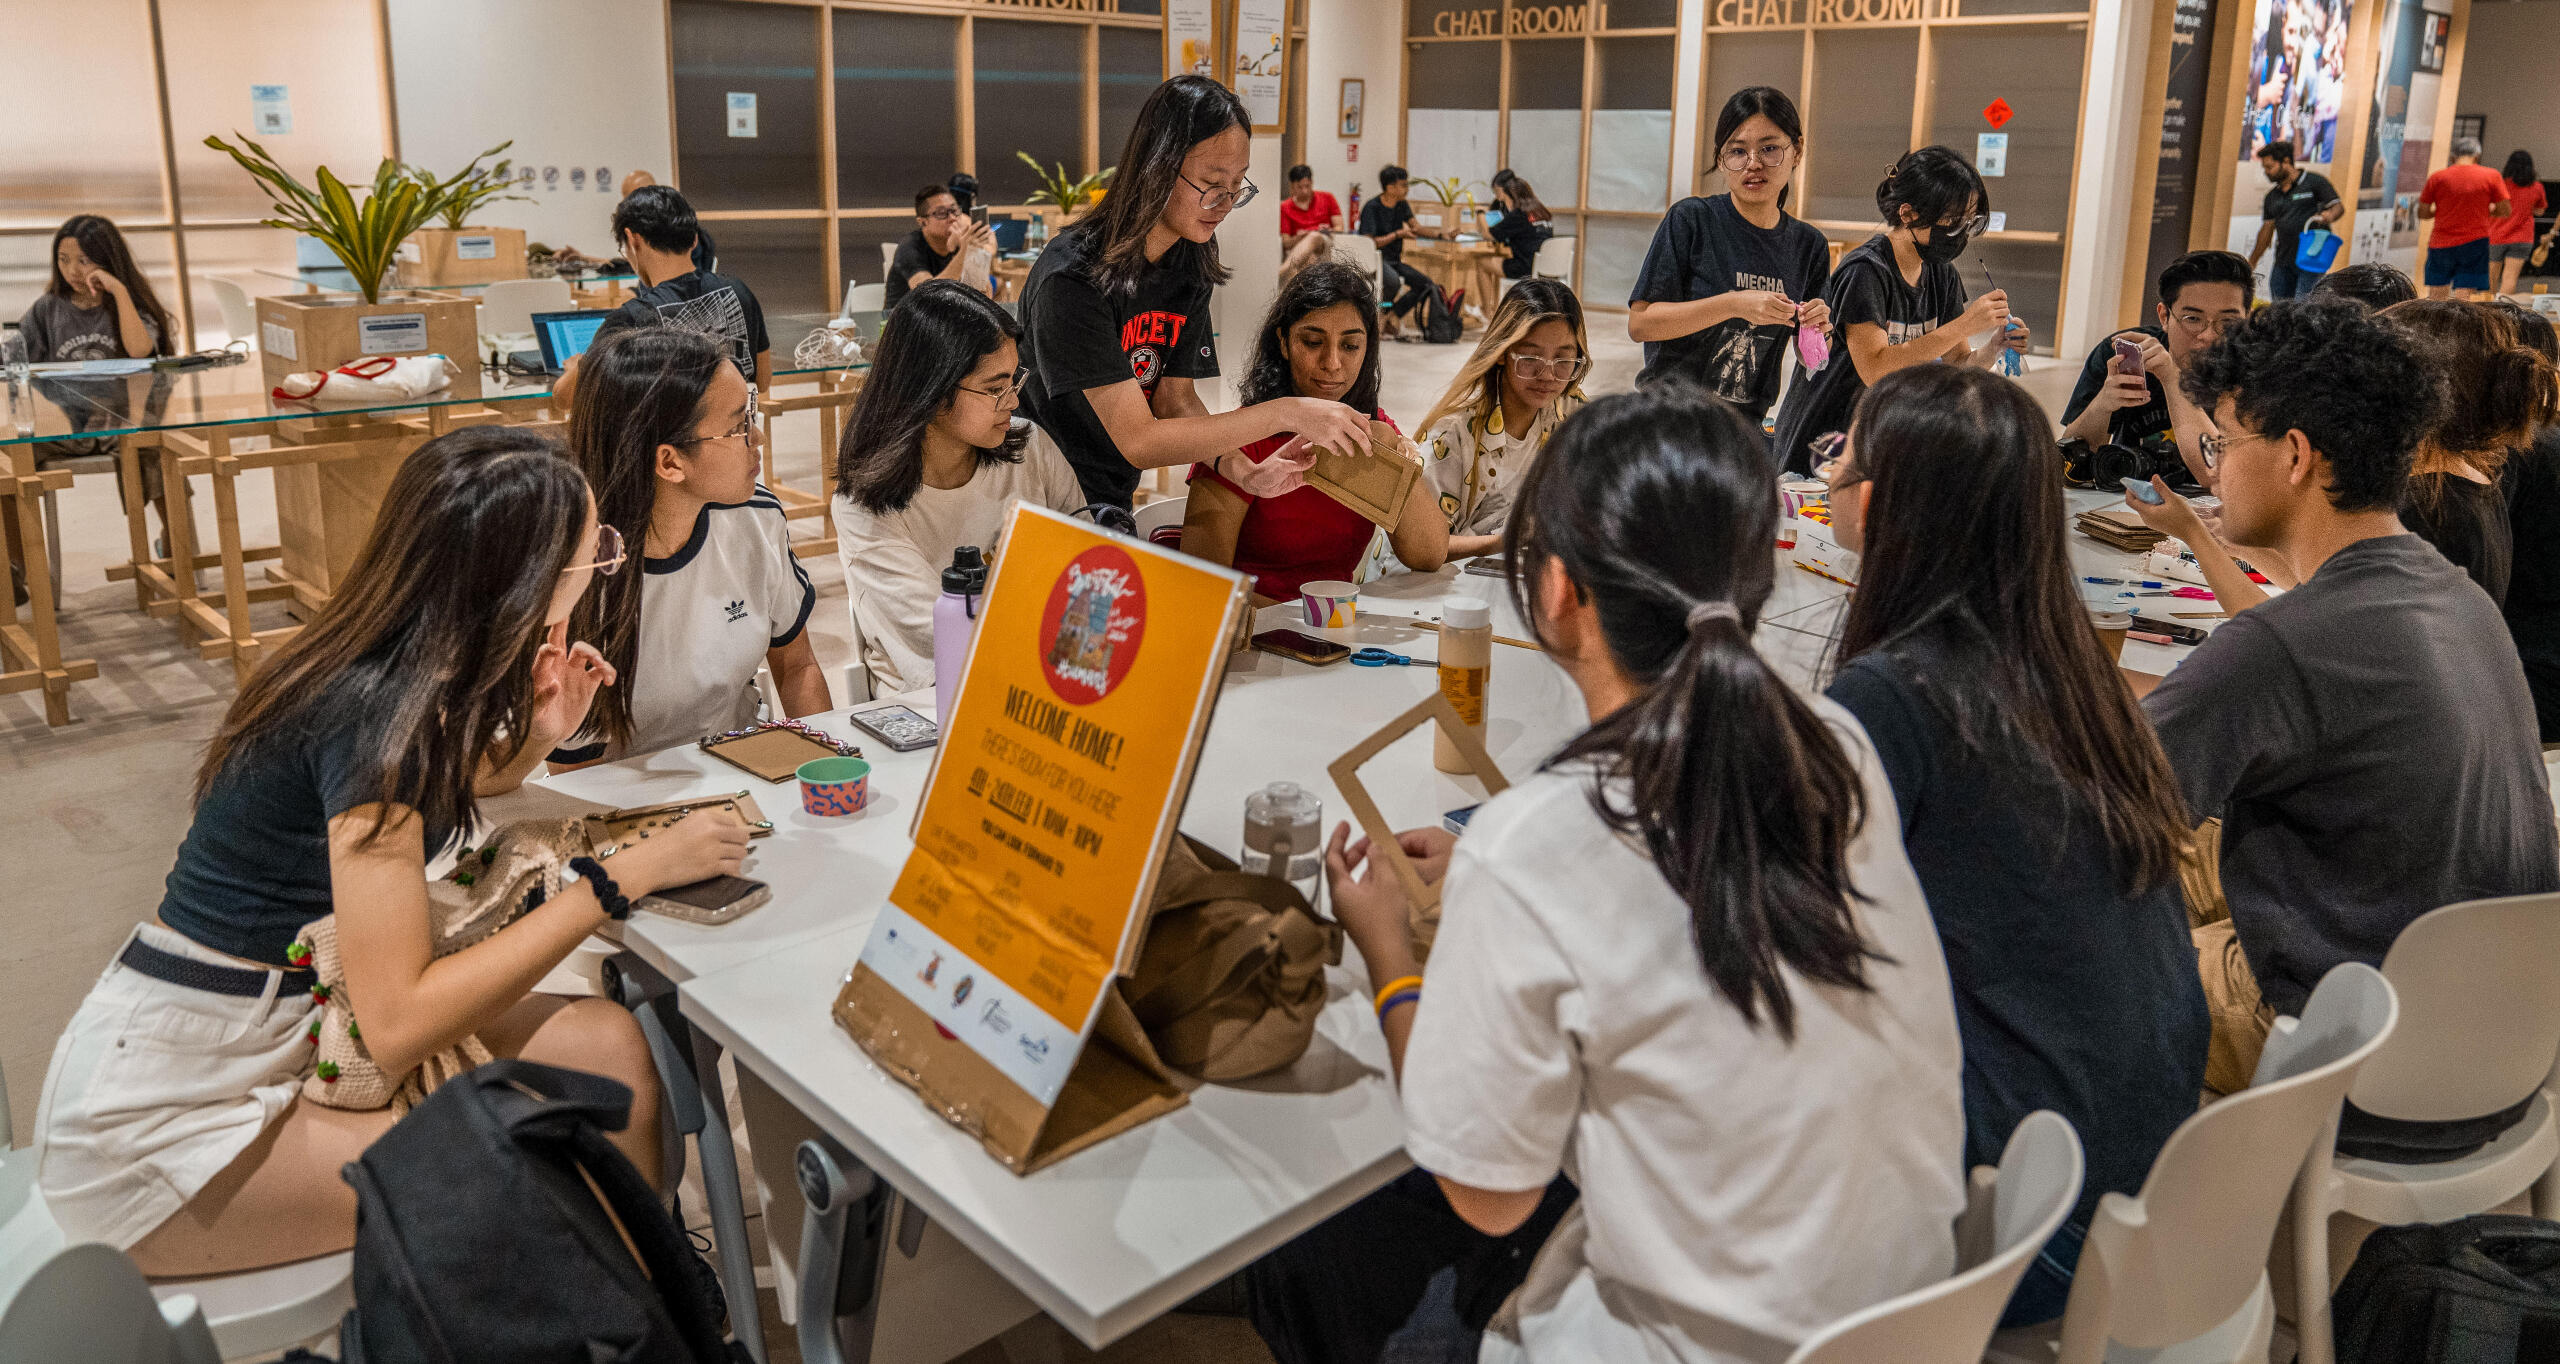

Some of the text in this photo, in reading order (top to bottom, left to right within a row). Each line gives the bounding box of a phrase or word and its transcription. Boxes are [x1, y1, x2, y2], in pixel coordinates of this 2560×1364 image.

[1433, 9, 1497, 37] CHAT
[1508, 5, 1588, 34] ROOM
[1716, 0, 1798, 26] CHAT
[1814, 0, 1921, 23] ROOM
[1736, 271, 1785, 294] MECHA
[727, 611, 748, 623] adidas
[1004, 683, 1125, 772] WELCOME HOME!
